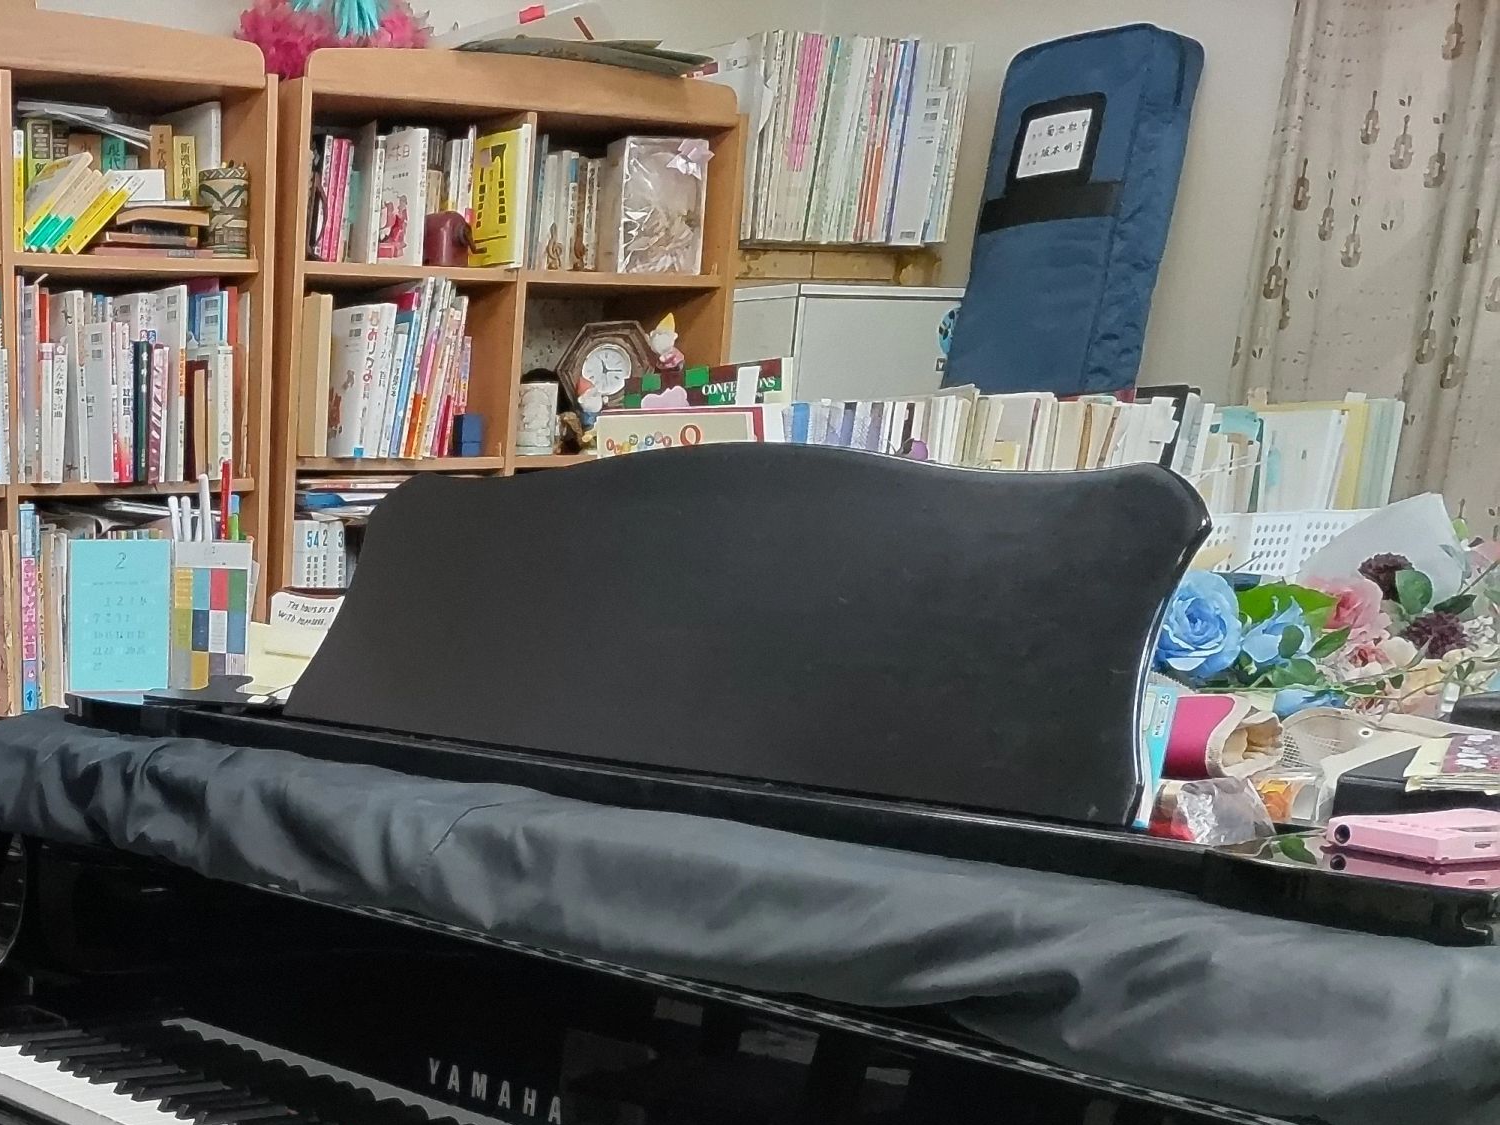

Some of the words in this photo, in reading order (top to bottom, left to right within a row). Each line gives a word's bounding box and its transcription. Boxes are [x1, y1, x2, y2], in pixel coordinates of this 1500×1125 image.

[322, 529, 328, 546] 2
[115, 551, 128, 570] 2
[429, 1057, 562, 1125] YAMAHA
